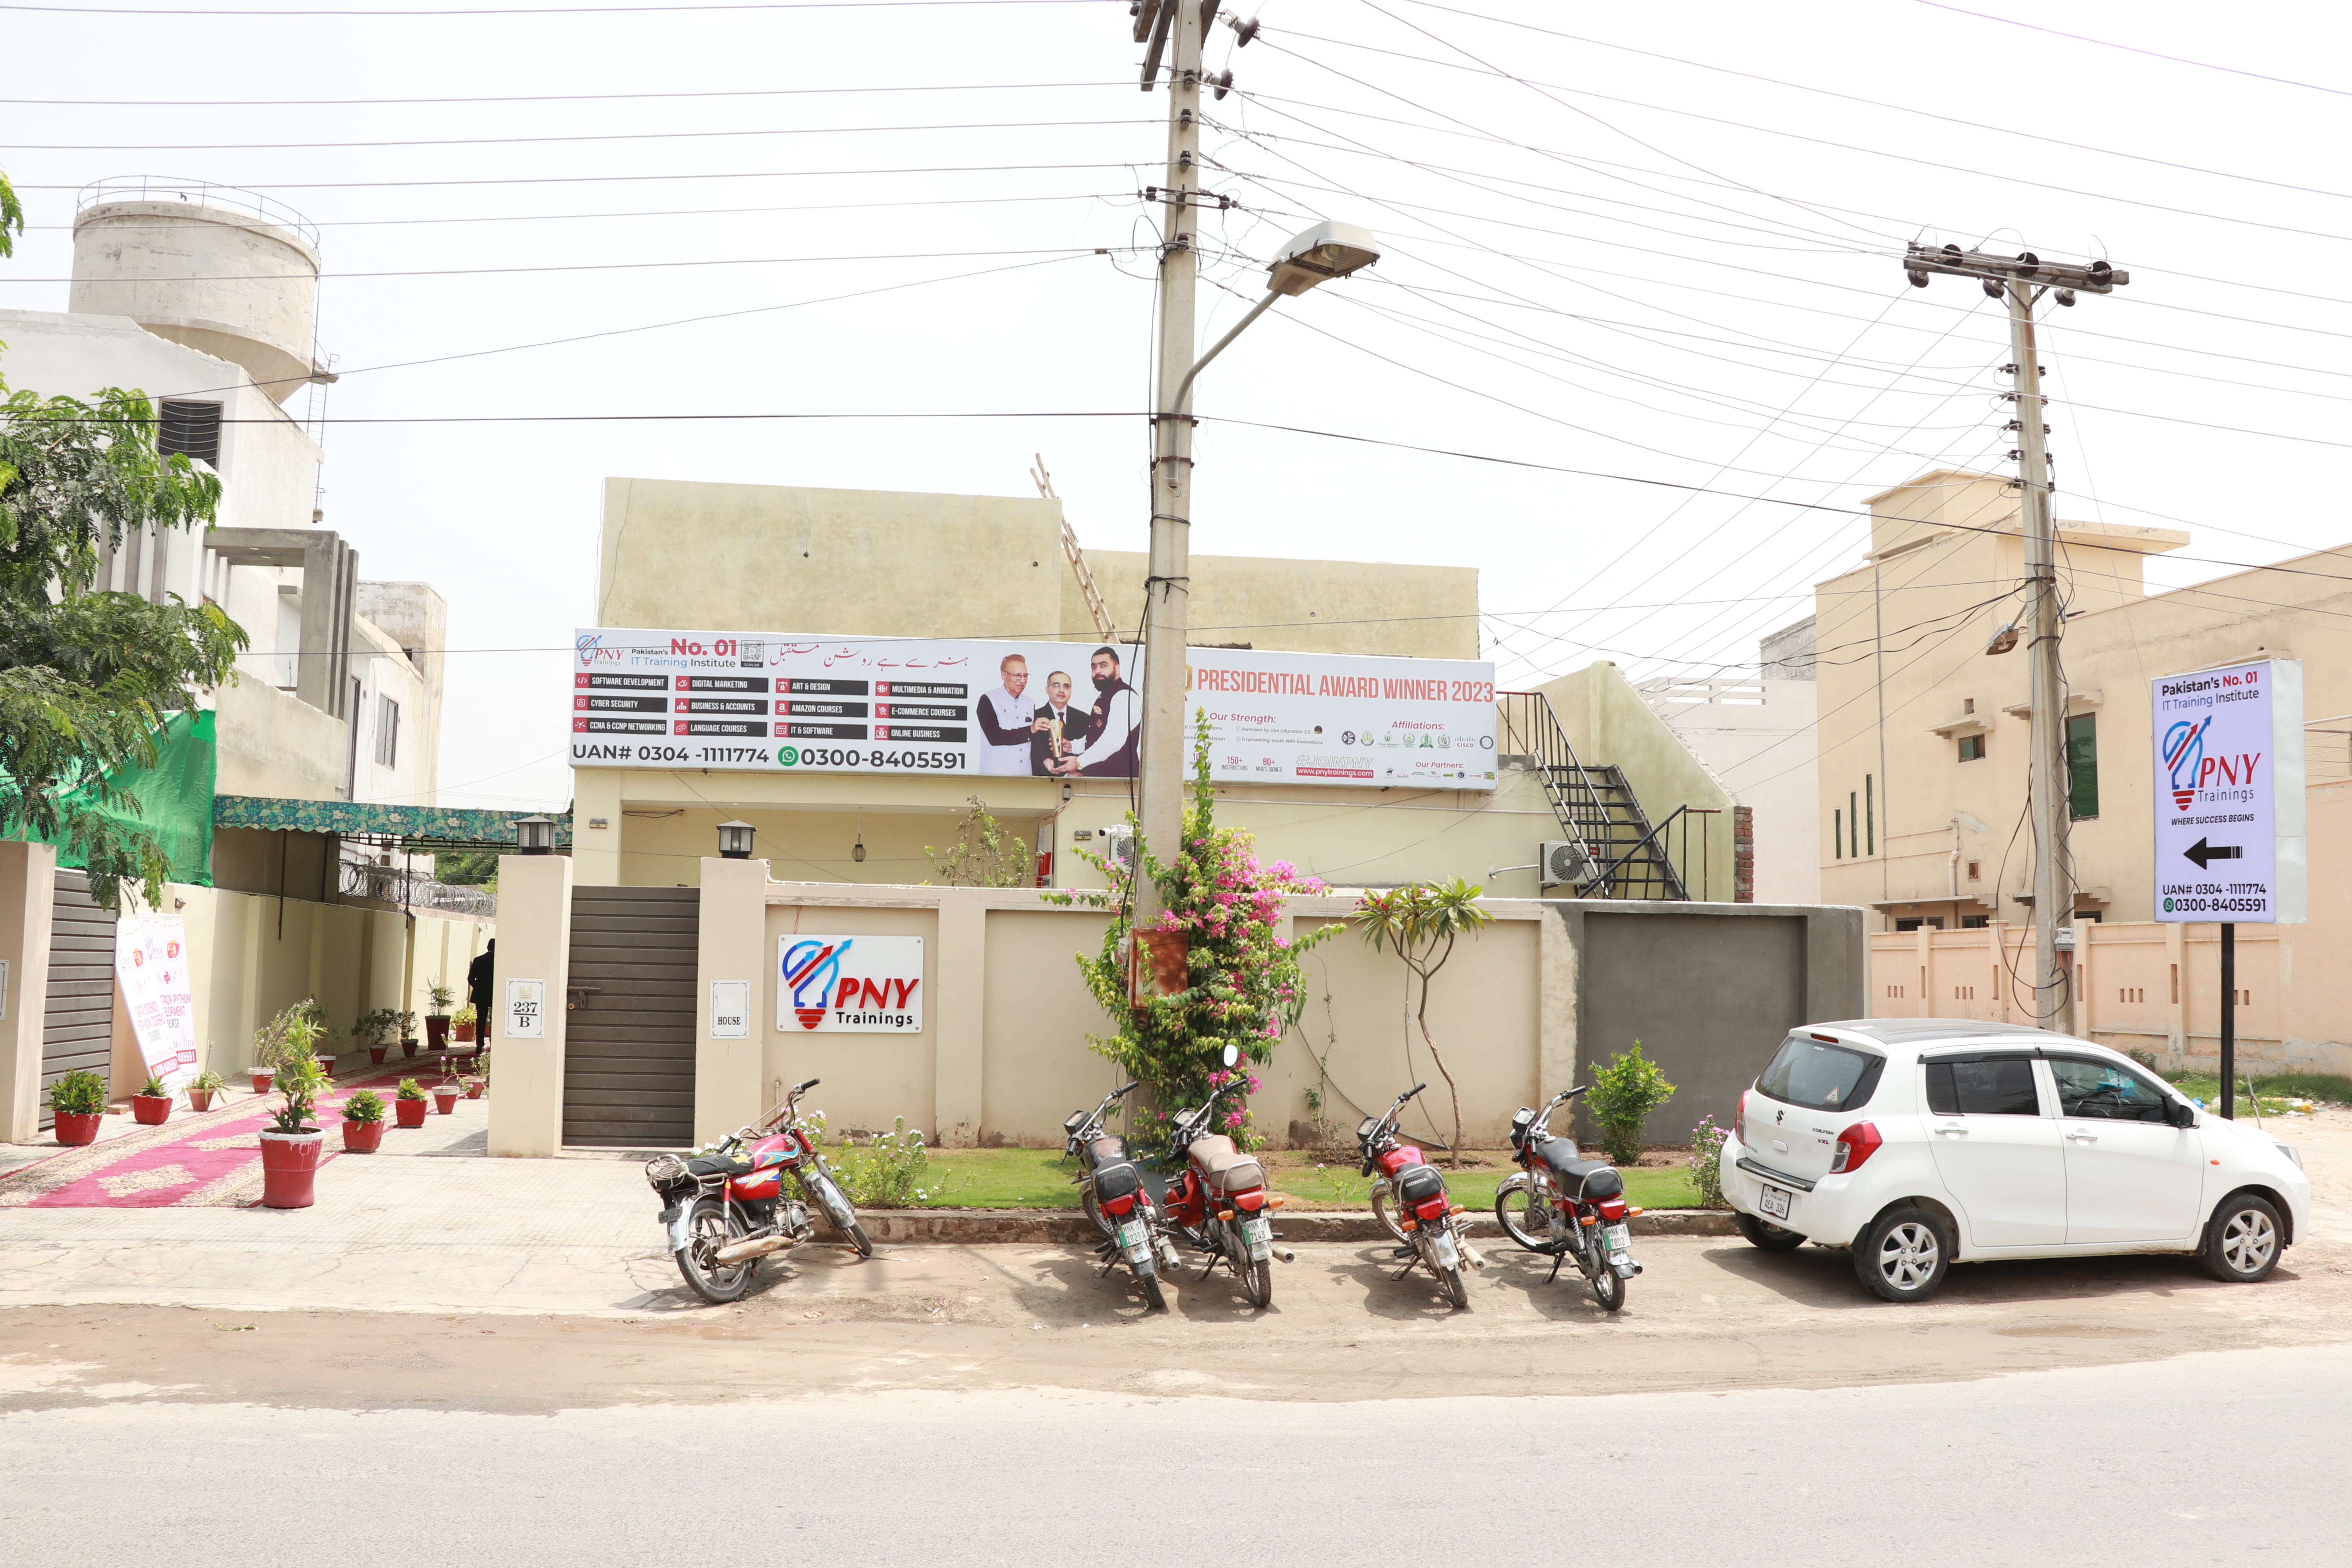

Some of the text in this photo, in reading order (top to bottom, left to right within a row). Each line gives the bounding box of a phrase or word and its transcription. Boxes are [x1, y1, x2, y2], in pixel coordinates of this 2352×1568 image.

[671, 638, 708, 656] No.
[714, 639, 736, 656] 01
[594, 649, 625, 660] PNY
[644, 657, 687, 668] Training
[691, 659, 736, 667] Institute
[592, 677, 664, 686] SOFTWARE DEVELOPMENT
[692, 680, 748, 689] DIGITAL MARKETING
[1198, 669, 1494, 702] PRESIDENTIAL AWARD WINNER 2023
[2162, 671, 2258, 696] Pakistan's No. 01
[892, 685, 926, 694] MULTIMEDIA
[2162, 689, 2259, 711] IT Training Institute
[892, 708, 956, 717] E-COMMERCE COURSES
[1210, 712, 1276, 724] Our Strength:
[612, 722, 627, 730] CCNP
[628, 723, 665, 731] NETWORKING
[1392, 720, 1445, 730] Affiliations:
[891, 729, 940, 738] ONLINE BUSINESS
[573, 744, 769, 763] UAN# 0304 -1111774
[801, 748, 965, 769] 0300-8405591
[1227, 756, 1243, 764] 150+
[1296, 754, 1374, 768] #JOINPNY
[1298, 768, 1372, 777] www.pnytrainings.com
[2199, 753, 2261, 788] PNY
[2198, 789, 2254, 802] Trainings
[2171, 814, 2254, 826] WHERE SUCCESS BEGINS
[2163, 884, 2267, 895] UAN# 0304 -1111774
[2175, 898, 2266, 911] 0300-8405591
[153, 947, 163, 956] PNY
[160, 993, 191, 1005] TACK PYTHON
[835, 978, 920, 1009] PNY
[514, 1002, 538, 1013] 237
[519, 1016, 530, 1027] B
[718, 1016, 741, 1025] HOUSE
[836, 1012, 913, 1027] Trainings
[1405, 1178, 1428, 1188] HONDA
[1764, 1199, 1784, 1214] AEA 336
[1250, 1230, 1265, 1242] 7143
[1620, 1226, 1626, 1235] 18
[1610, 1237, 1625, 1247] 7802
